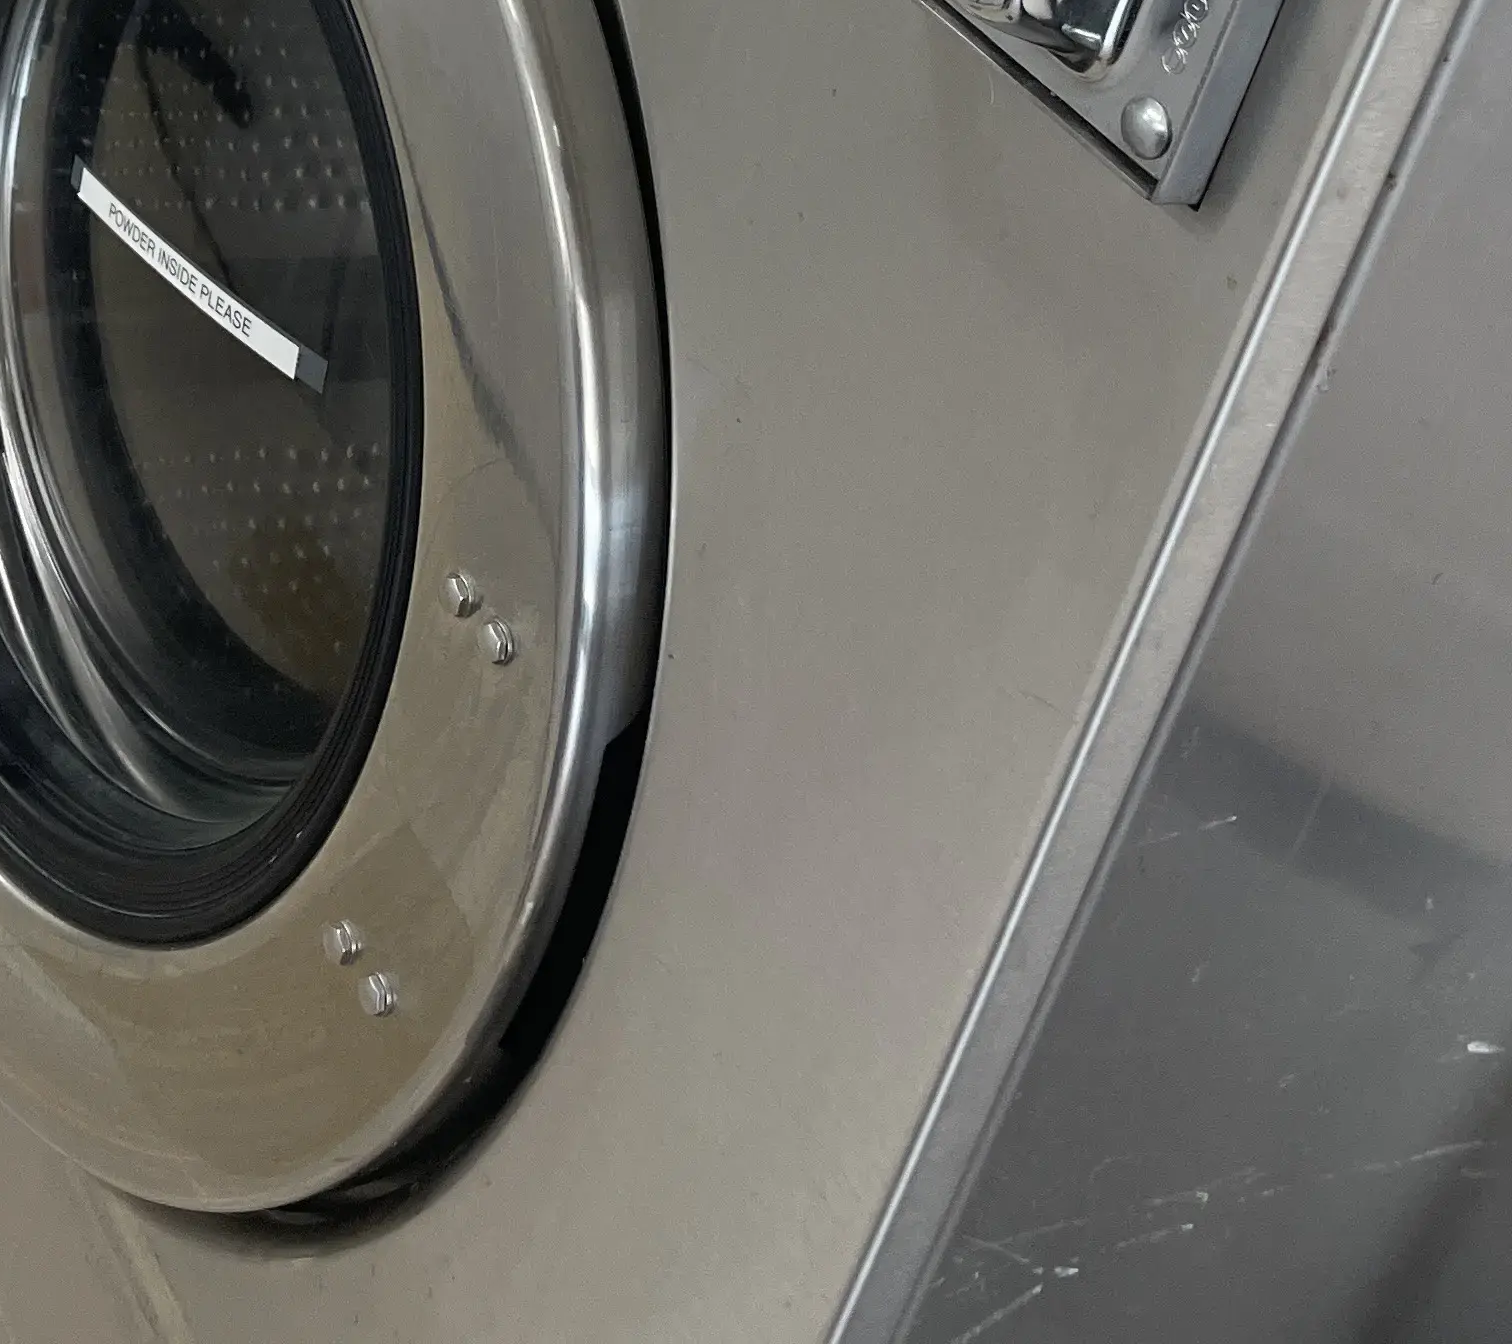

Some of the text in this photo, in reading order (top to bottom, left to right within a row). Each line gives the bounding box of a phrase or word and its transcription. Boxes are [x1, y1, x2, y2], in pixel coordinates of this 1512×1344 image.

[107, 202, 253, 338] POWDER INSIDE PLEASE
